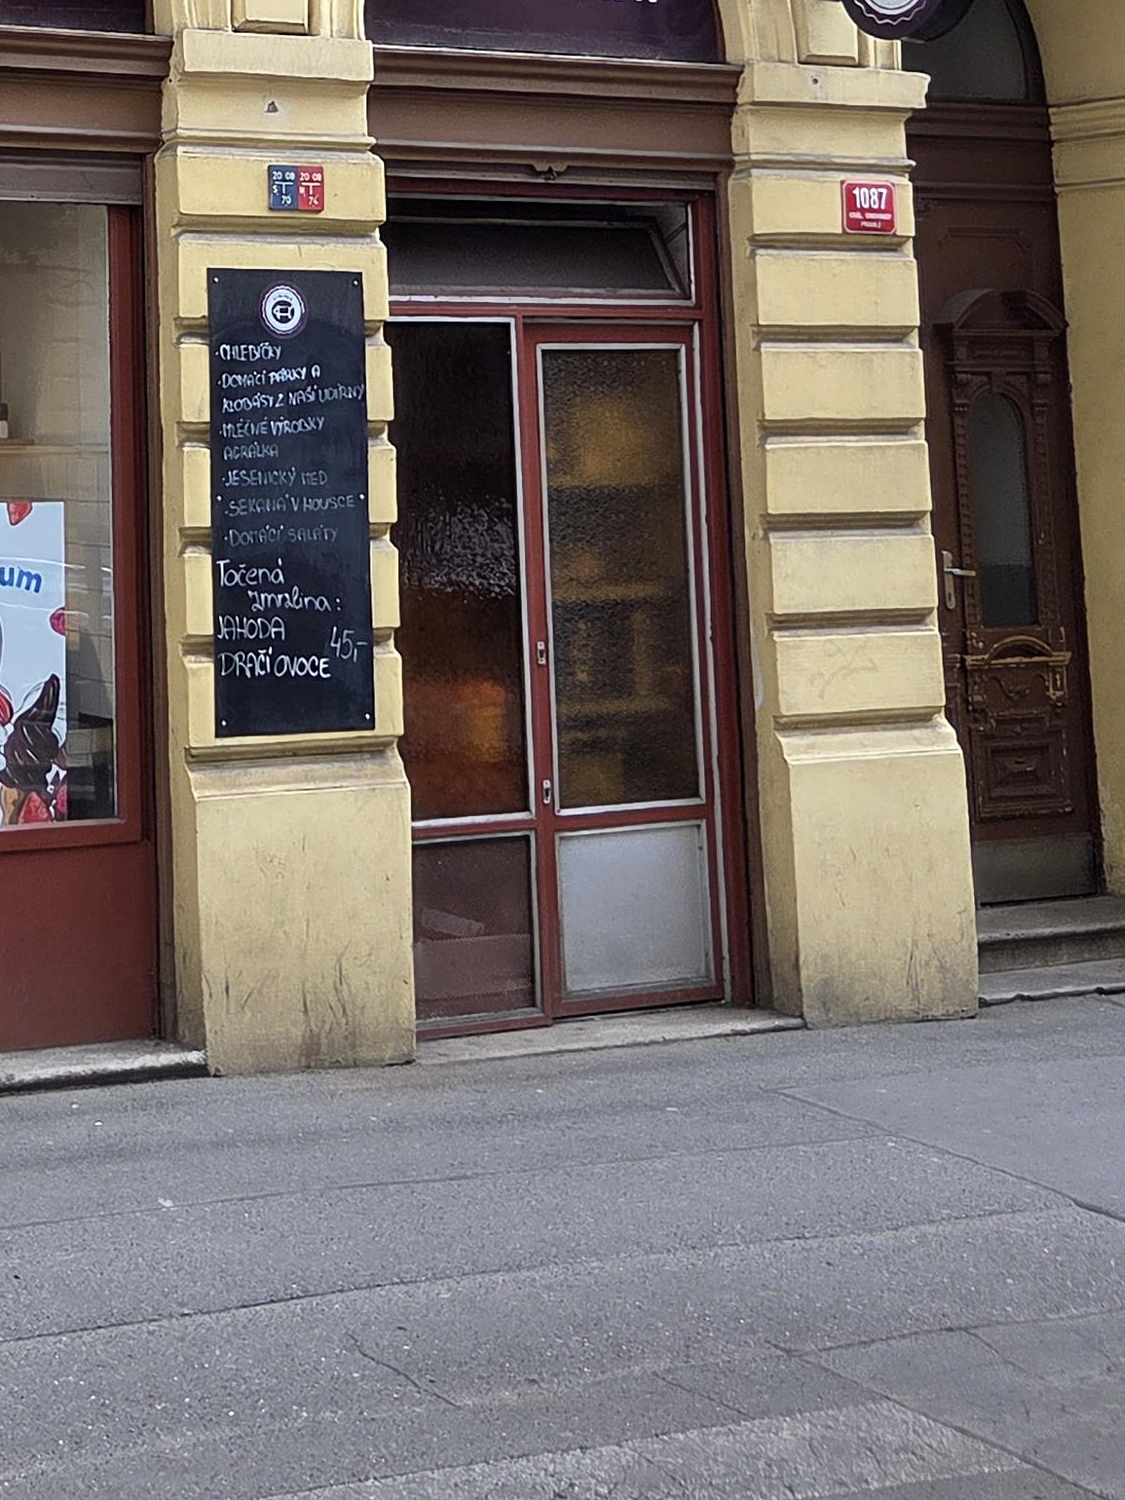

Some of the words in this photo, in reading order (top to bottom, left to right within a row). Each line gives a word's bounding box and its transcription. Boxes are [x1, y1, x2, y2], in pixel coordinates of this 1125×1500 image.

[852, 186, 887, 210] 1087
[311, 364, 321, 379] A
[216, 557, 285, 587] Točená
[217, 615, 285, 641] JAHODA
[274, 654, 332, 678] OVOCE
